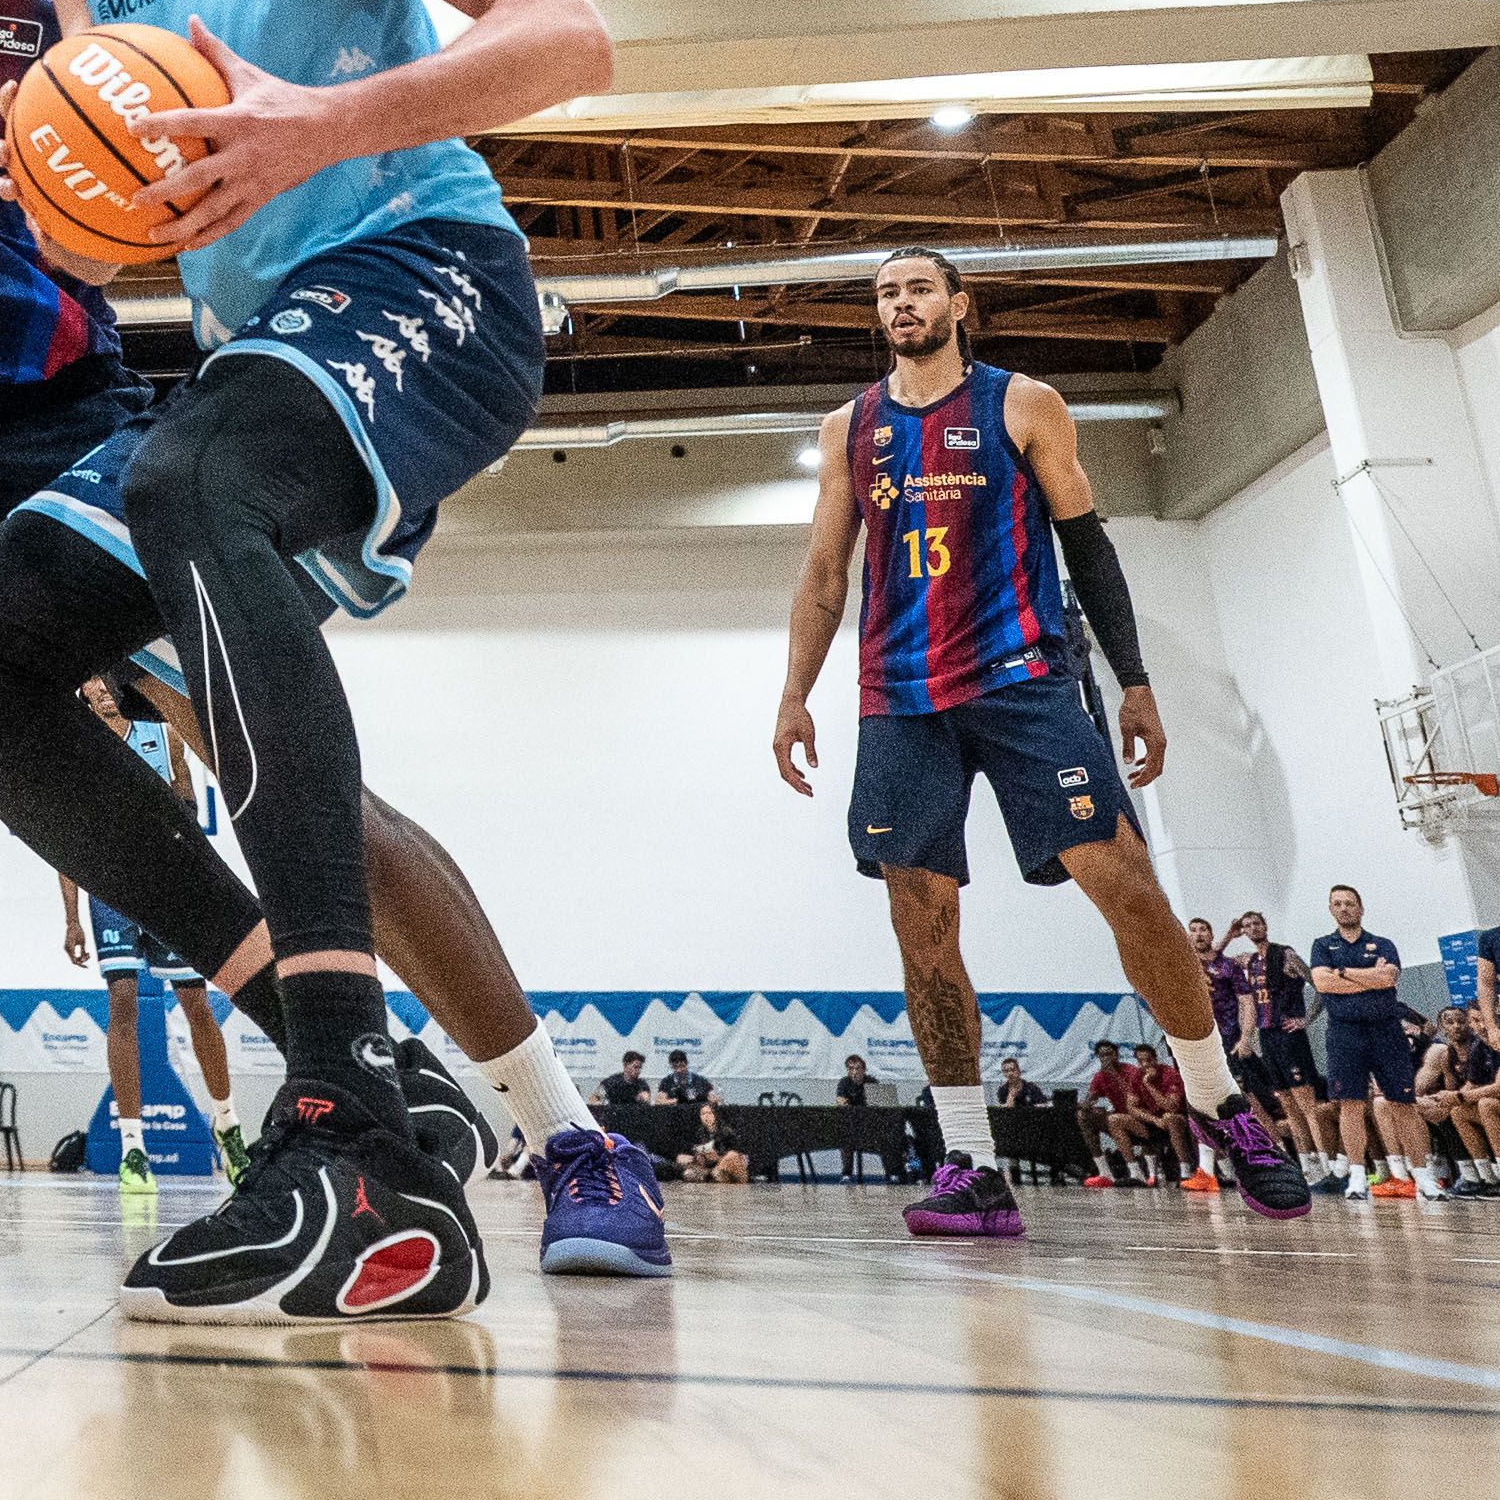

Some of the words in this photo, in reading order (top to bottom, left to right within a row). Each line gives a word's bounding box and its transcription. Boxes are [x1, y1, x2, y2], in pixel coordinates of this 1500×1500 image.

[902, 470, 987, 488] Assistència
[903, 485, 962, 503] Sanitària
[902, 526, 951, 578] 13
[109, 1100, 186, 1119] Eamp
